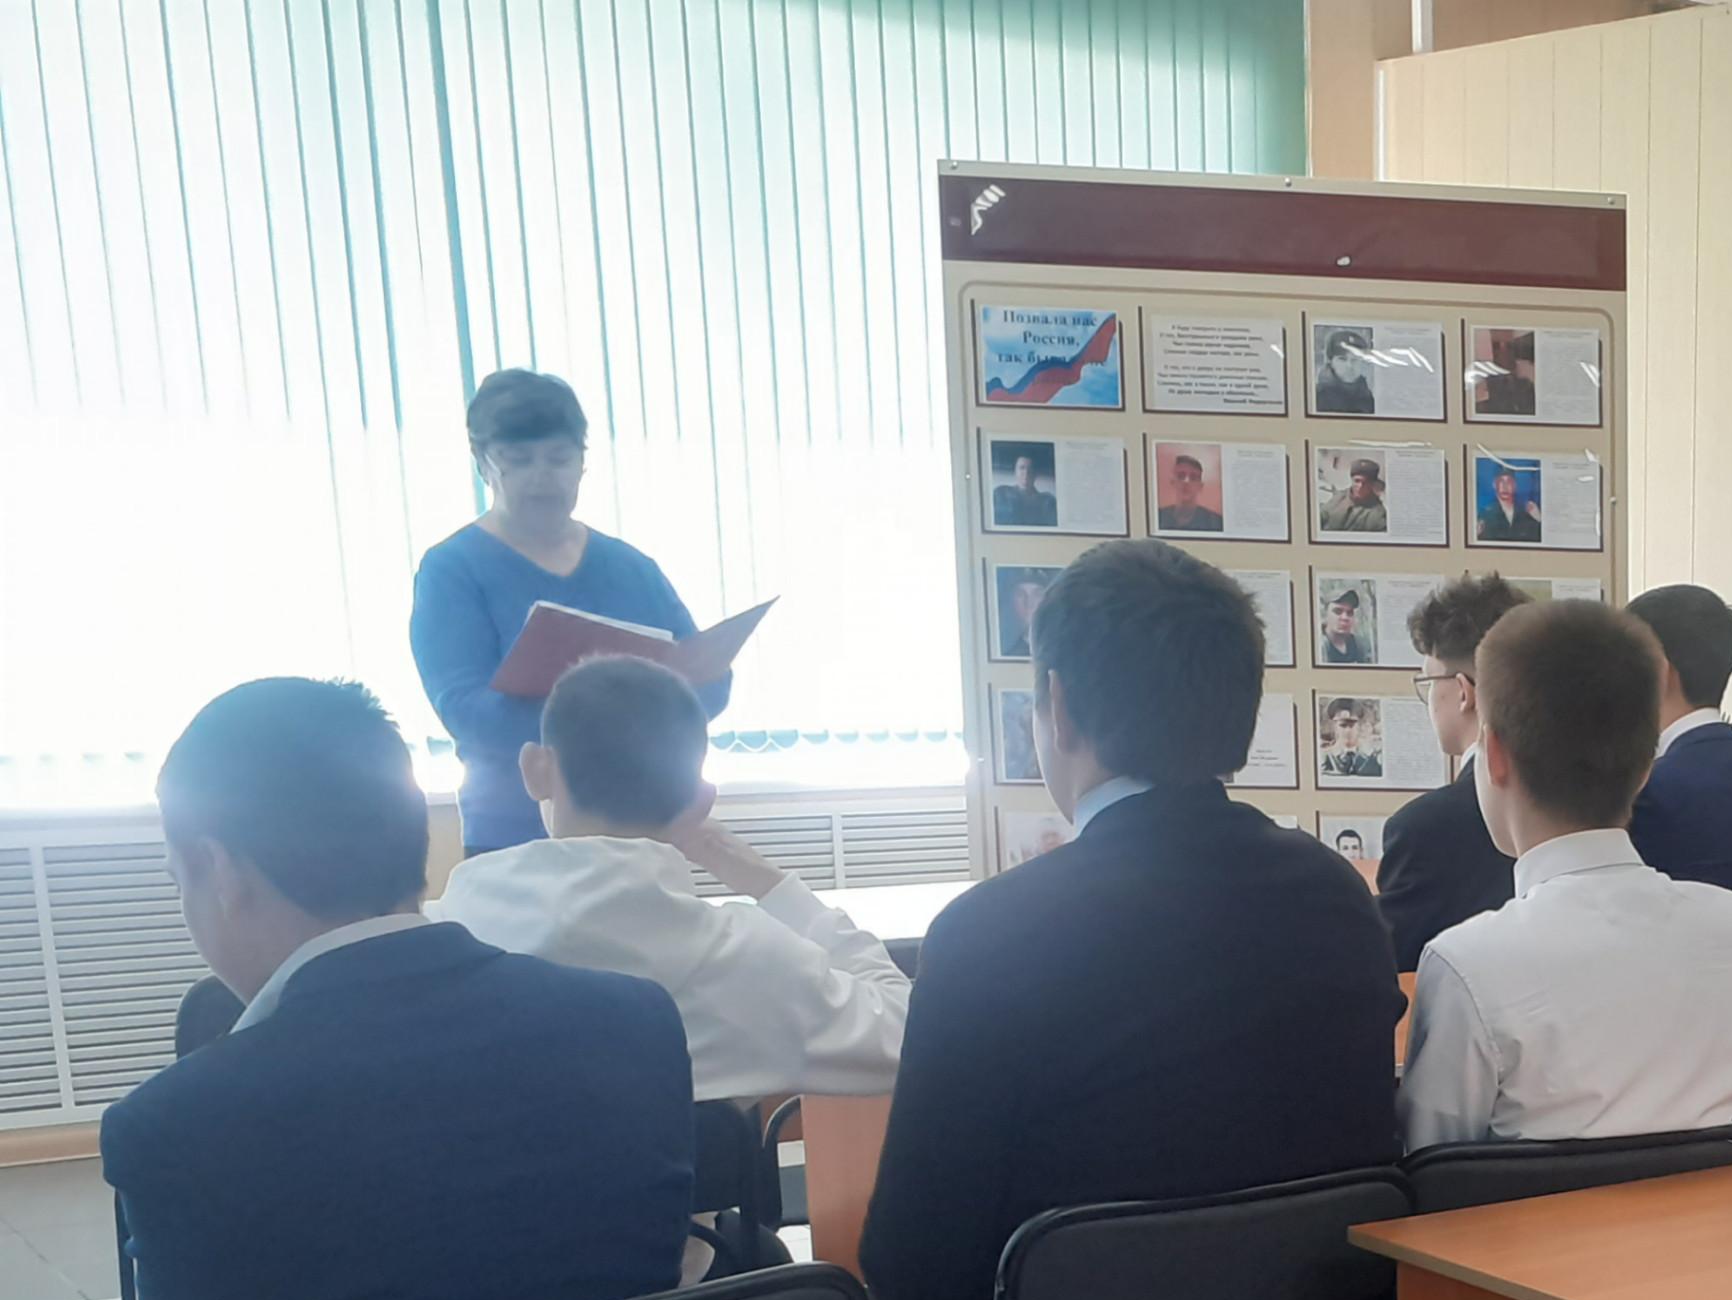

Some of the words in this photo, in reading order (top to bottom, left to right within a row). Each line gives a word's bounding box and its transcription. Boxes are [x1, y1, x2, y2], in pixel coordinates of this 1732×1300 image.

[1003, 309, 1068, 326] Позвала
[1071, 315, 1098, 327] нас
[1022, 330, 1080, 347] Россия,
[998, 353, 1022, 364] так
